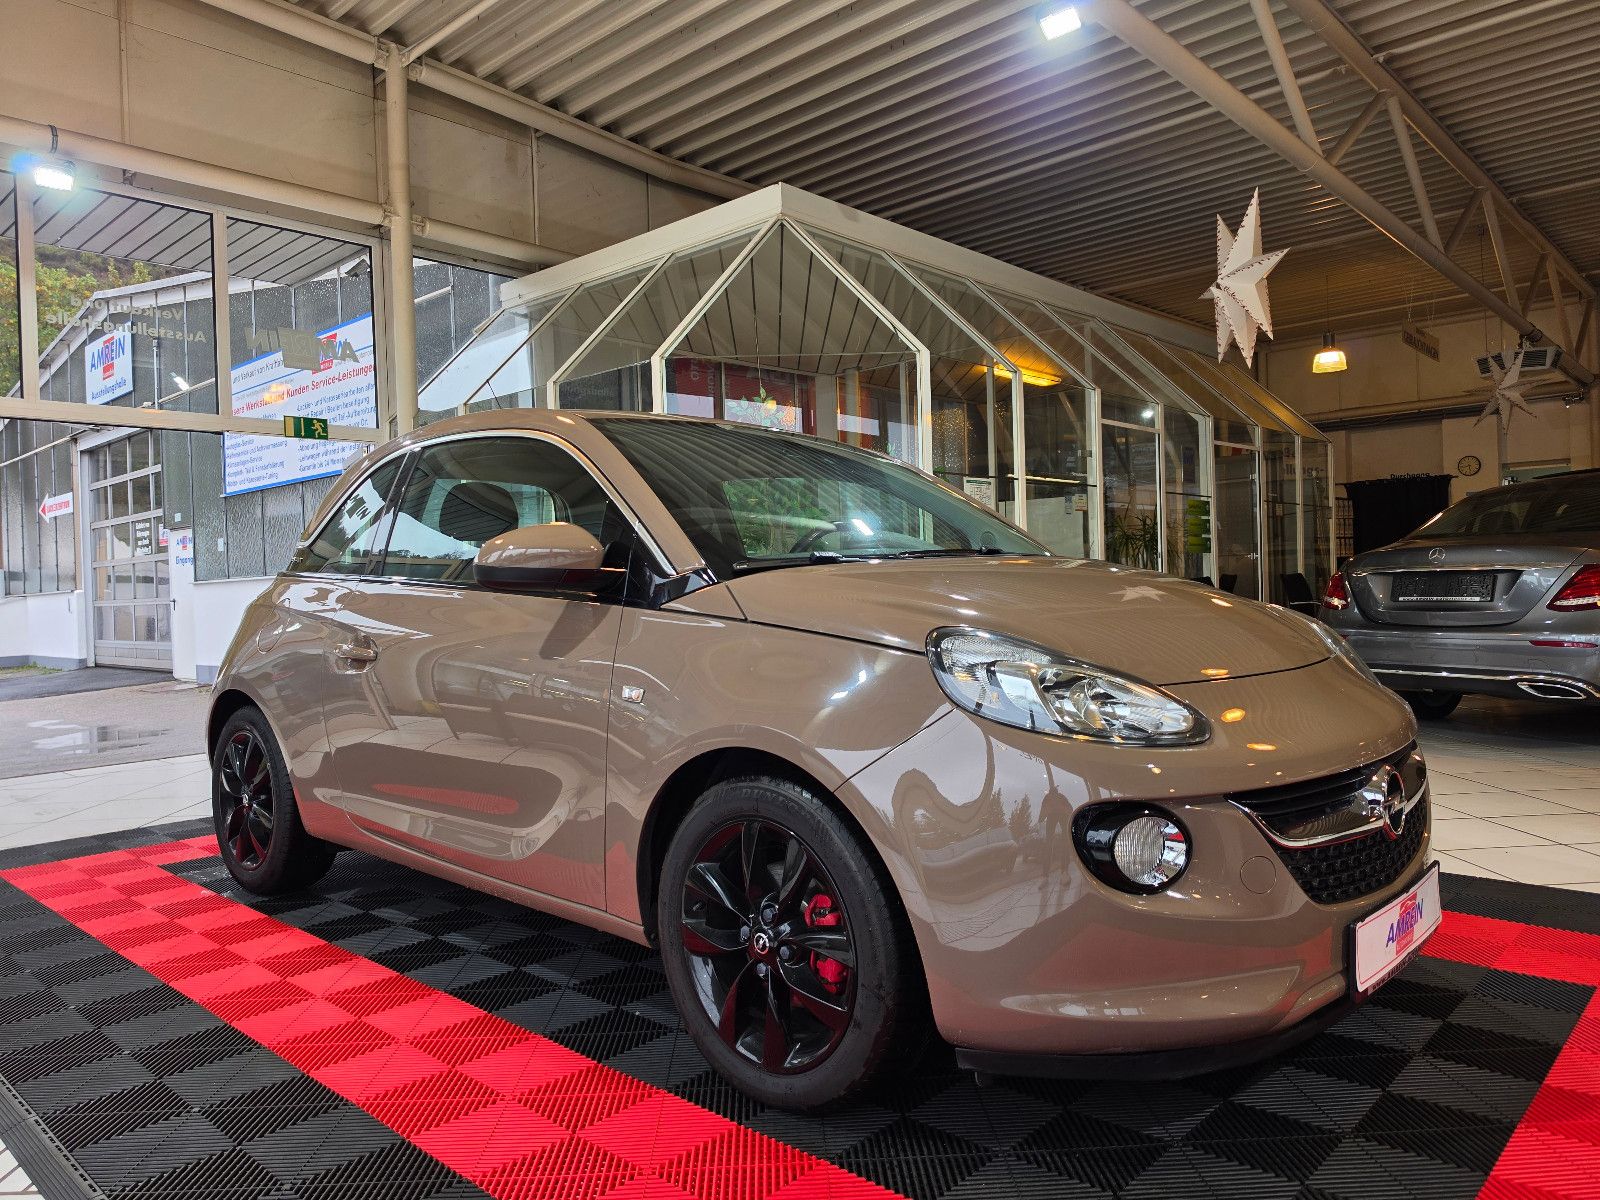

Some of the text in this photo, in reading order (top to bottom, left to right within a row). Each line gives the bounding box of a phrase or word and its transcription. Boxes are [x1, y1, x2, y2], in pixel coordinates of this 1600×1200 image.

[90, 335, 126, 372] AMREIN
[287, 384, 310, 399] Kunden
[1386, 898, 1424, 948] AMREIN
